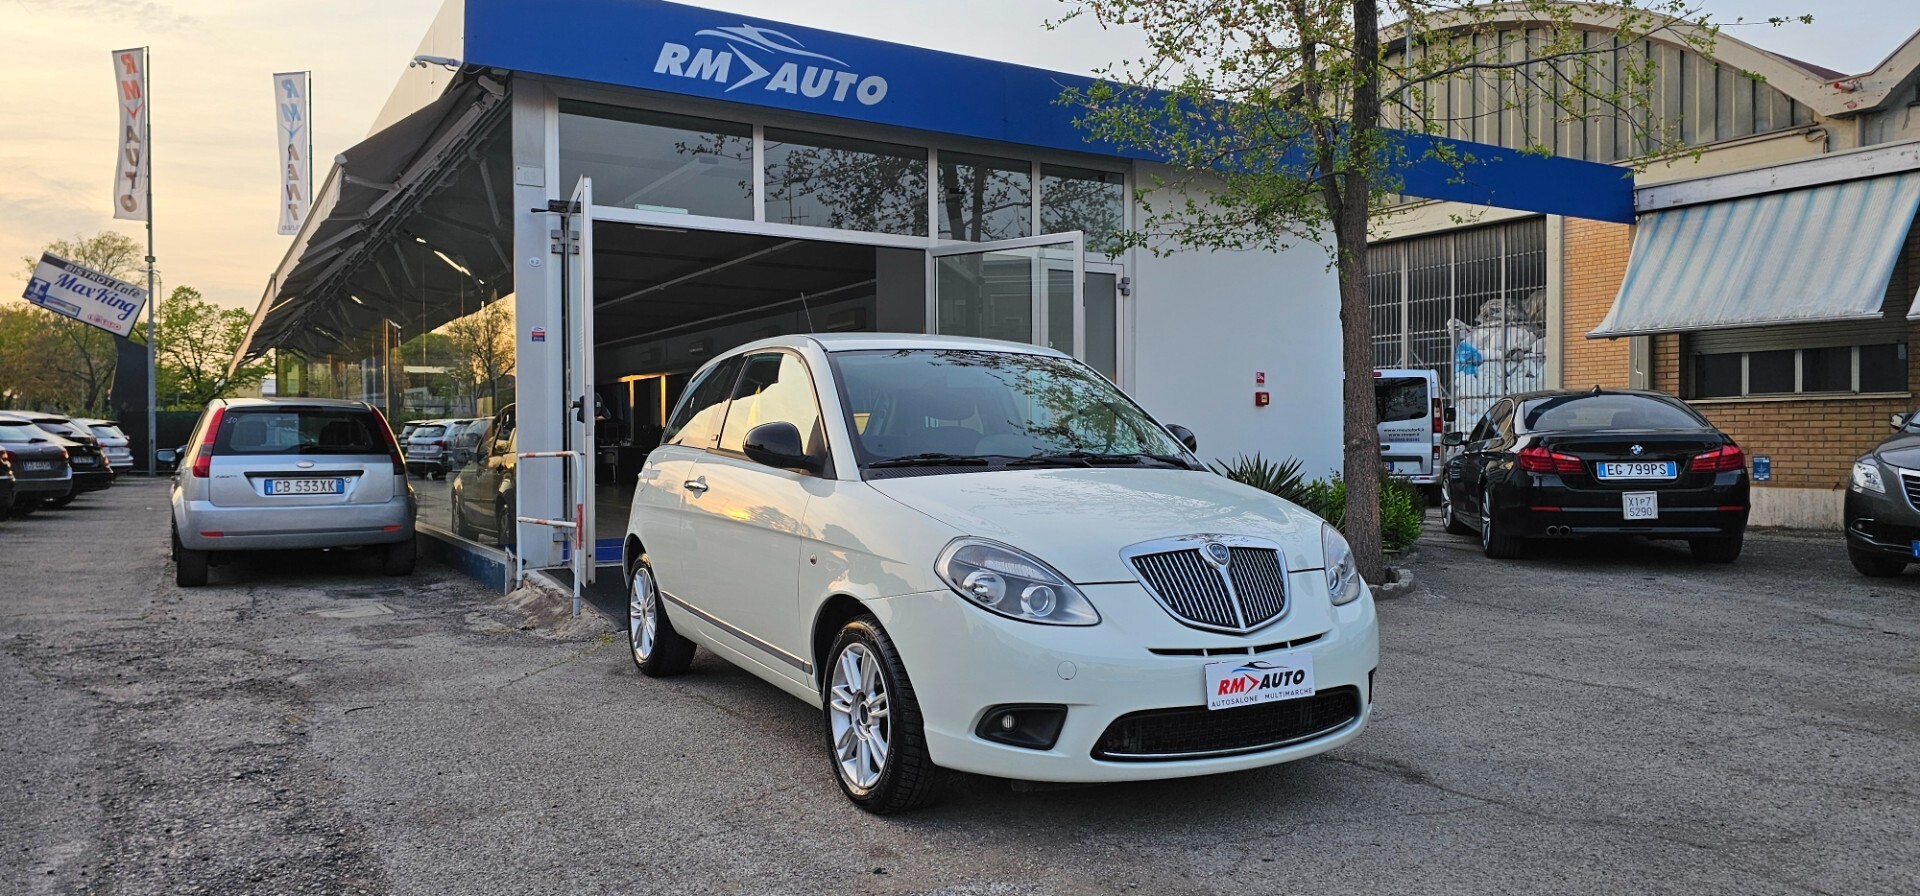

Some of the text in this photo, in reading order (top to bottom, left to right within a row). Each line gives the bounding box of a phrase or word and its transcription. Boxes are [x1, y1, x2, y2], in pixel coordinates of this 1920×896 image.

[653, 42, 888, 106] RM AUTO
[1607, 464, 1623, 475] EG
[1627, 464, 1667, 475] 799PS
[274, 481, 291, 493] CB
[295, 480, 335, 492] 533XK
[1629, 507, 1653, 517] 5290
[1217, 669, 1306, 696] RM AUTO
[1211, 687, 1313, 708] AUTOSALONE MULTIMARCHE
